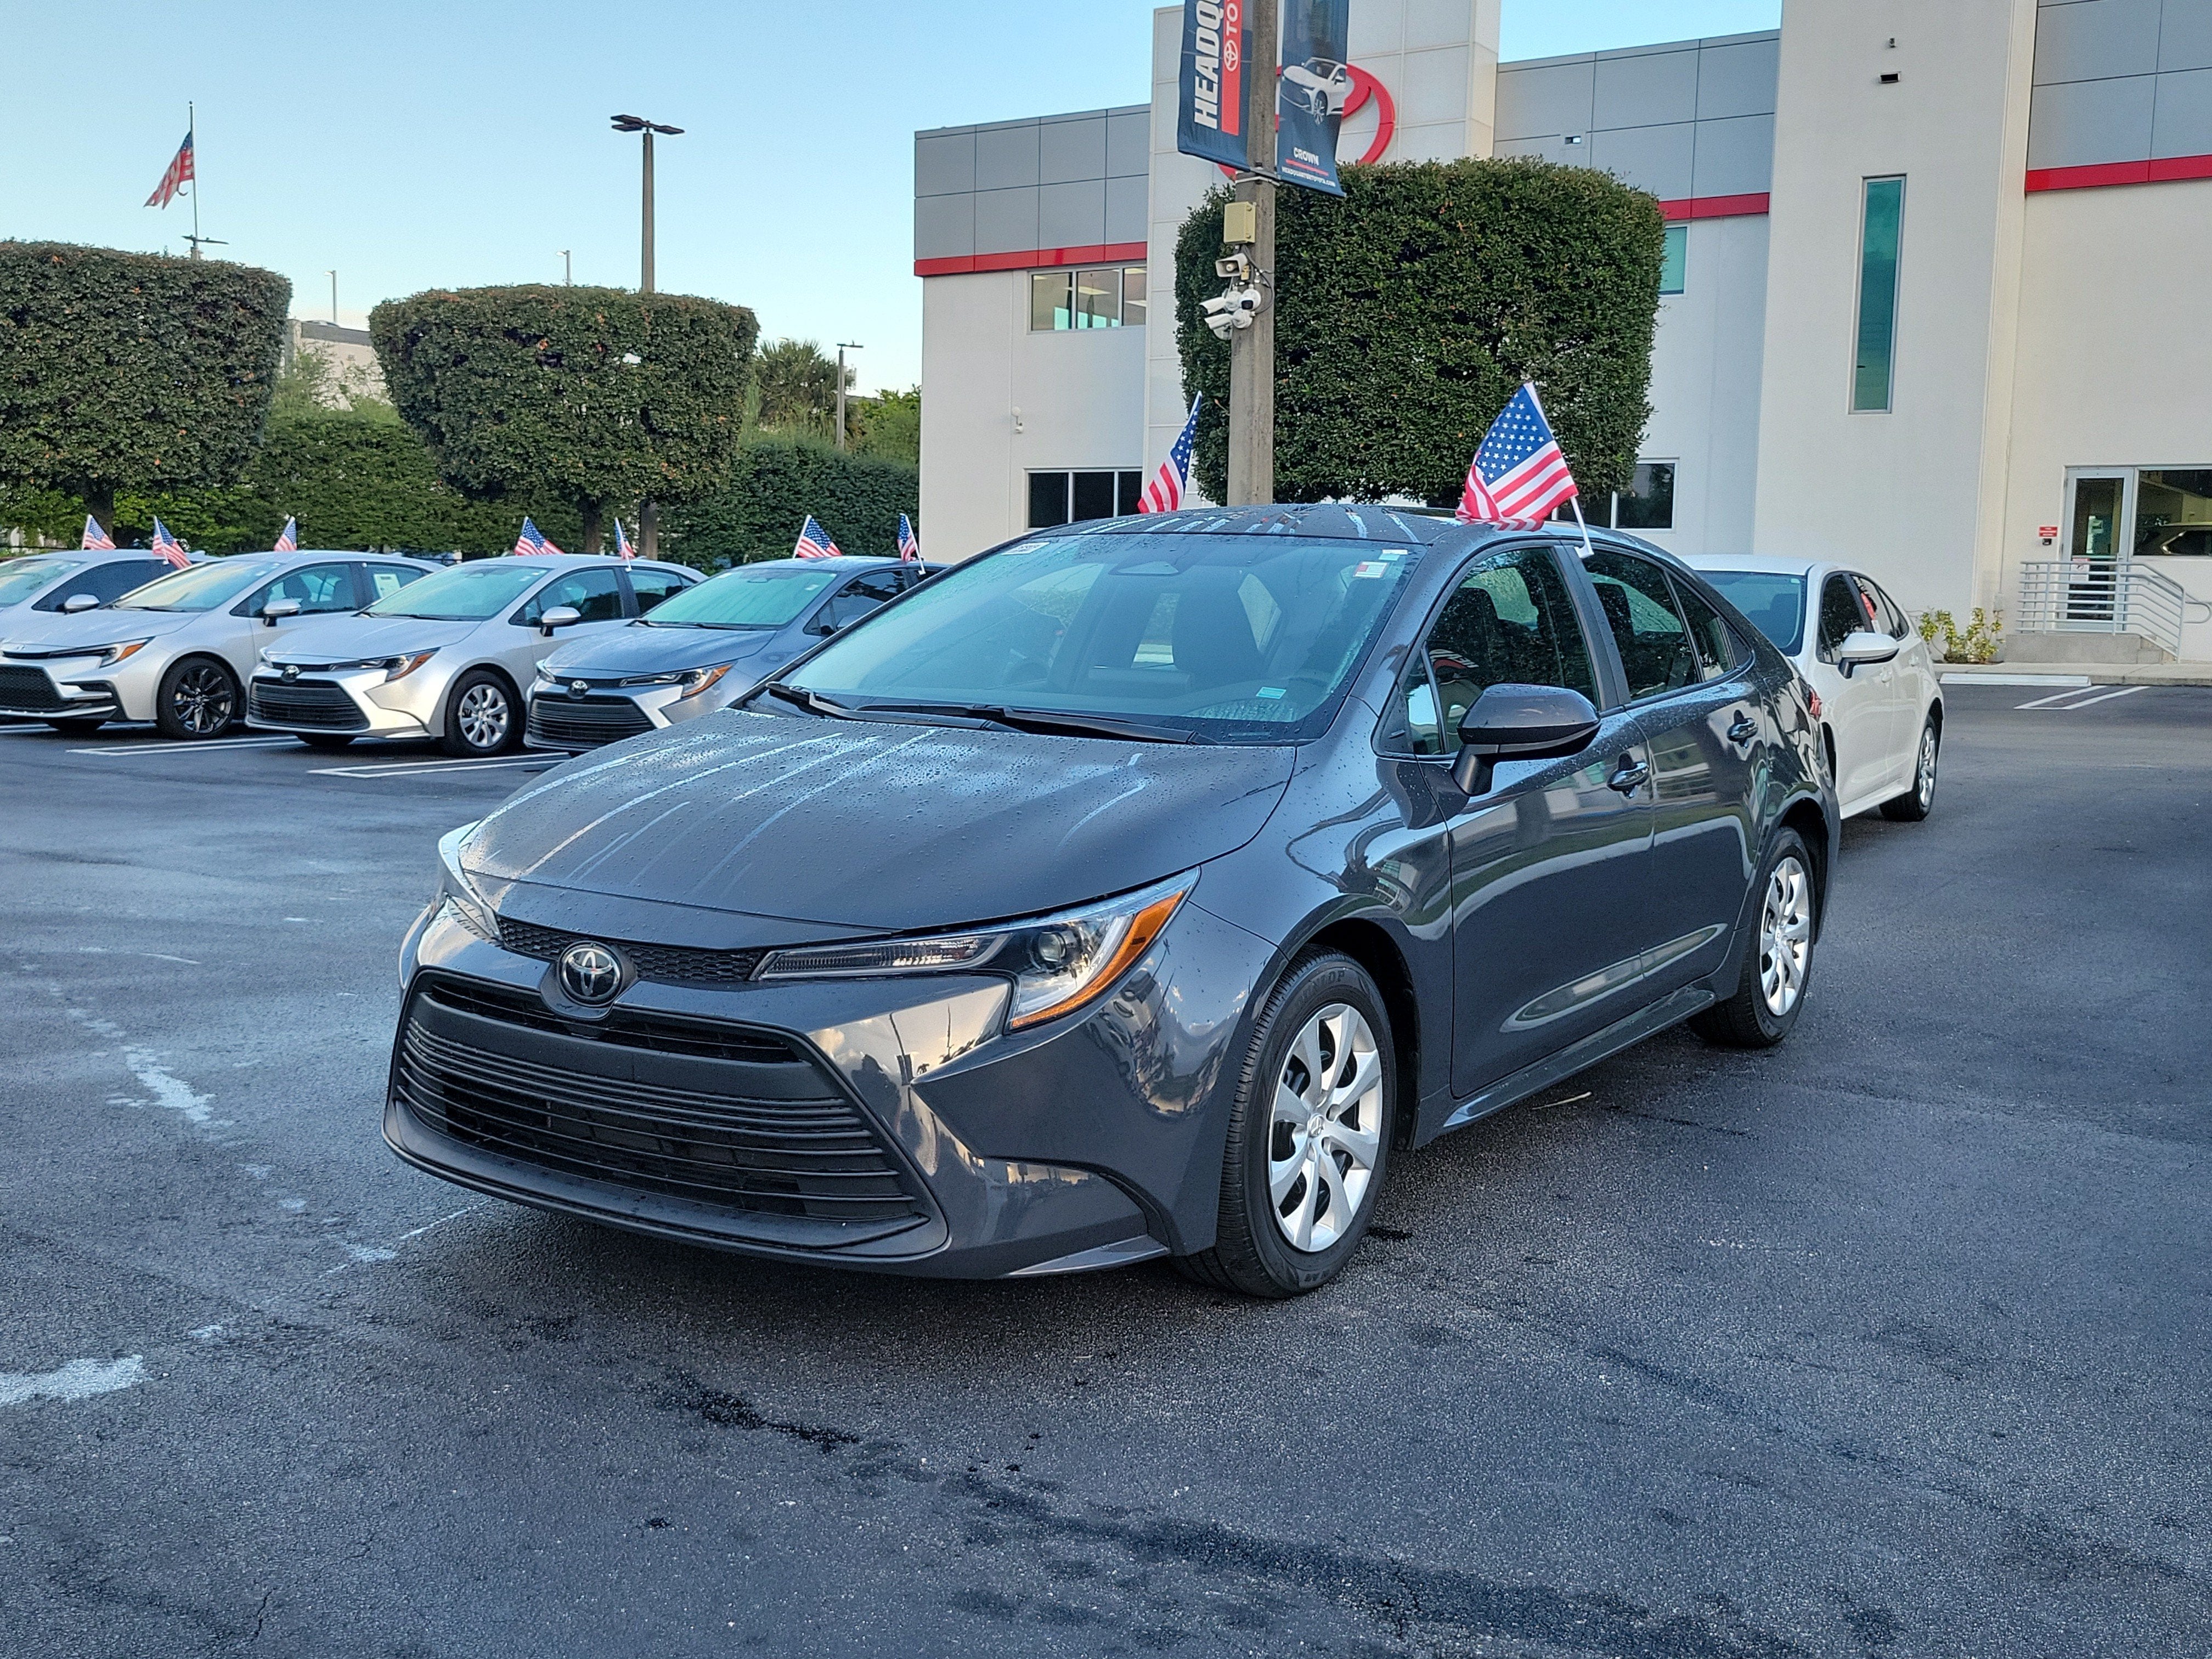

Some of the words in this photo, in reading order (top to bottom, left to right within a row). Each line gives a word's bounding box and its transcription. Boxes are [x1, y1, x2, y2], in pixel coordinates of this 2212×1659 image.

[1226, 0, 1238, 36] TO
[1194, 0, 1224, 130] HEADQ
[1293, 146, 1319, 166] CROWN
